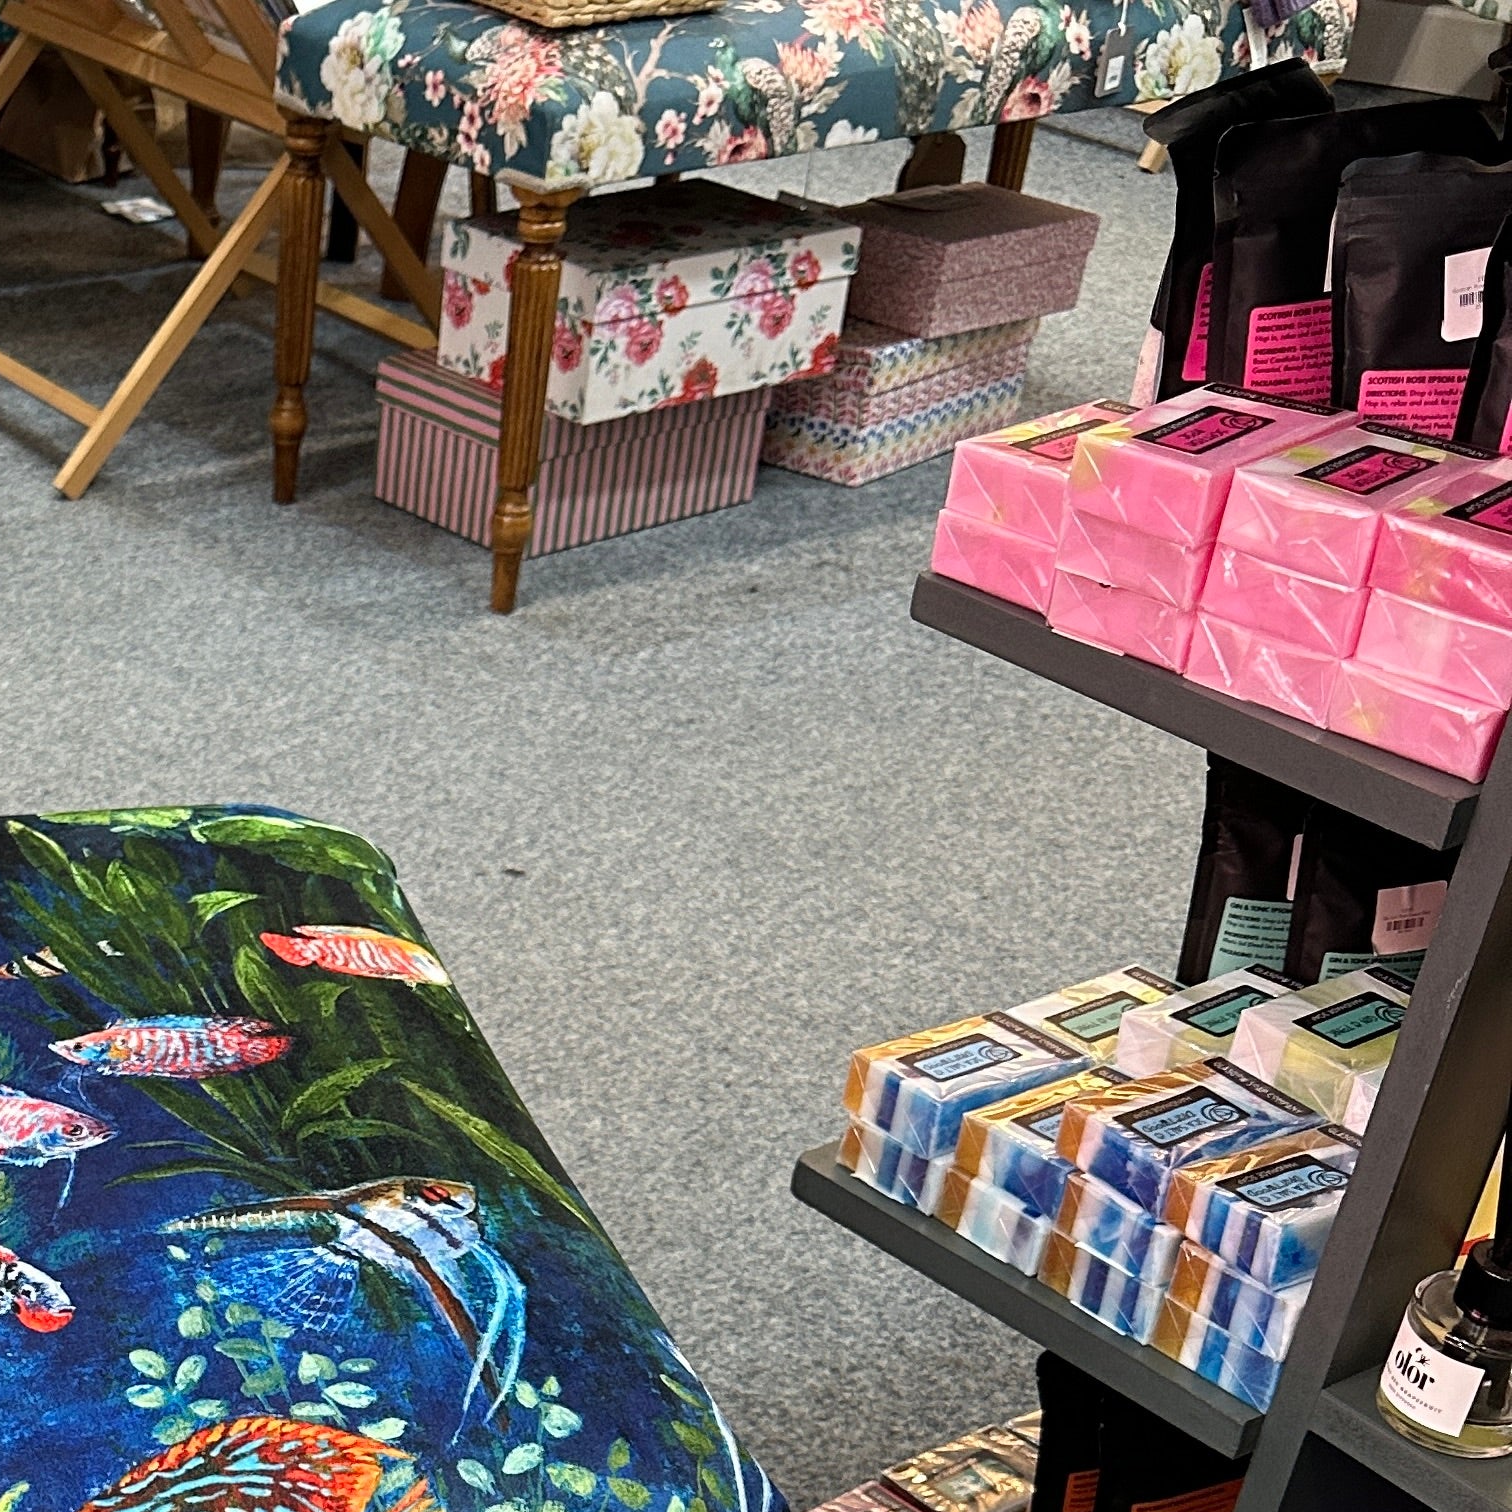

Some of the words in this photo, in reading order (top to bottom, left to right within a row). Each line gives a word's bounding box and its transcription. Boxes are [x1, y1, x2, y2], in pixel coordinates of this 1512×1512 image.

[1188, 1117, 1207, 1128] SEA
[1166, 1124, 1187, 1137] SALT
[1395, 1350, 1436, 1391] olor
